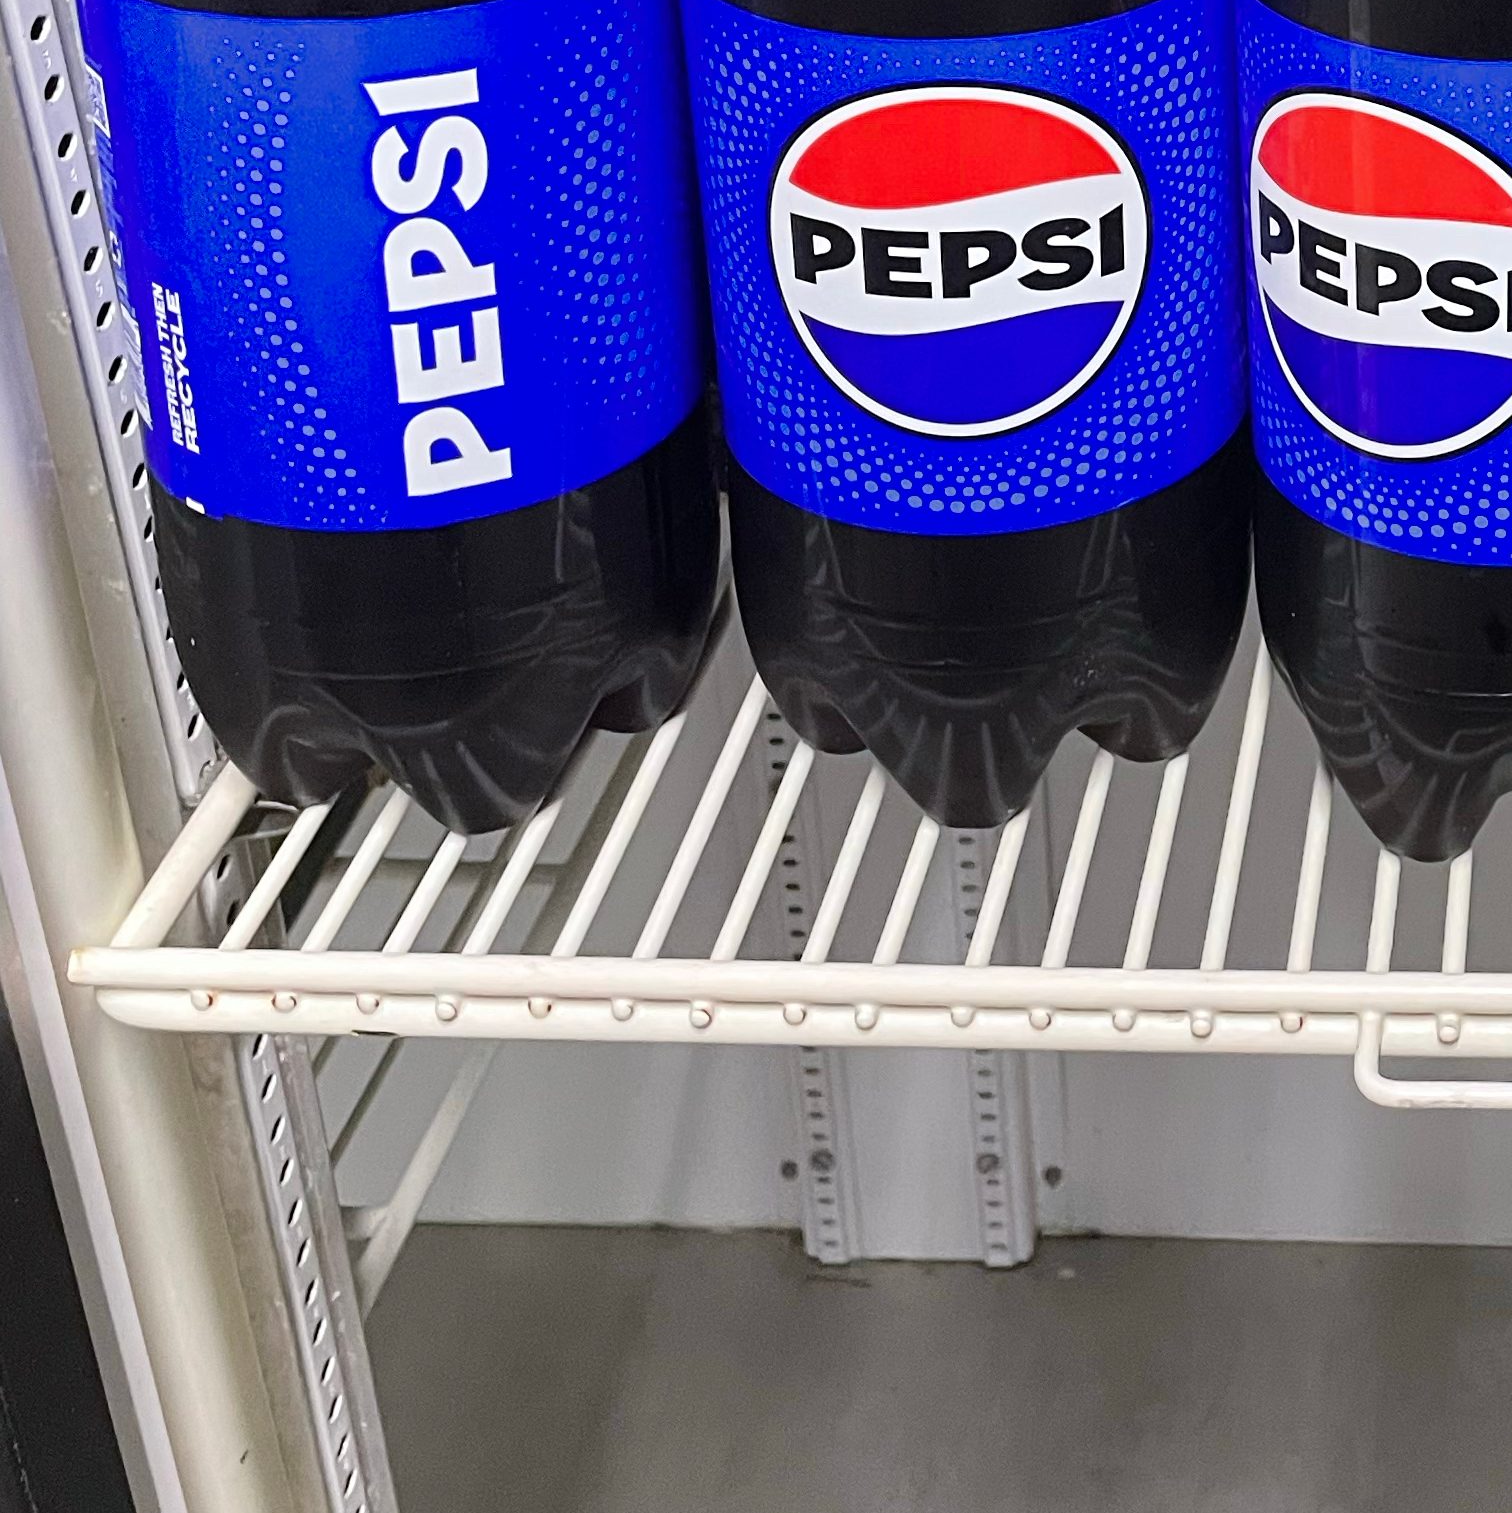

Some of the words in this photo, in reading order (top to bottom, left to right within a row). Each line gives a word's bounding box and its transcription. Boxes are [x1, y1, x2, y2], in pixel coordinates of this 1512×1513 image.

[361, 67, 512, 497] PEPSI
[788, 200, 1125, 300] PEPSI
[151, 282, 171, 342] THEN
[160, 345, 184, 446] REFRESH
[165, 288, 200, 455] RECYCLE
